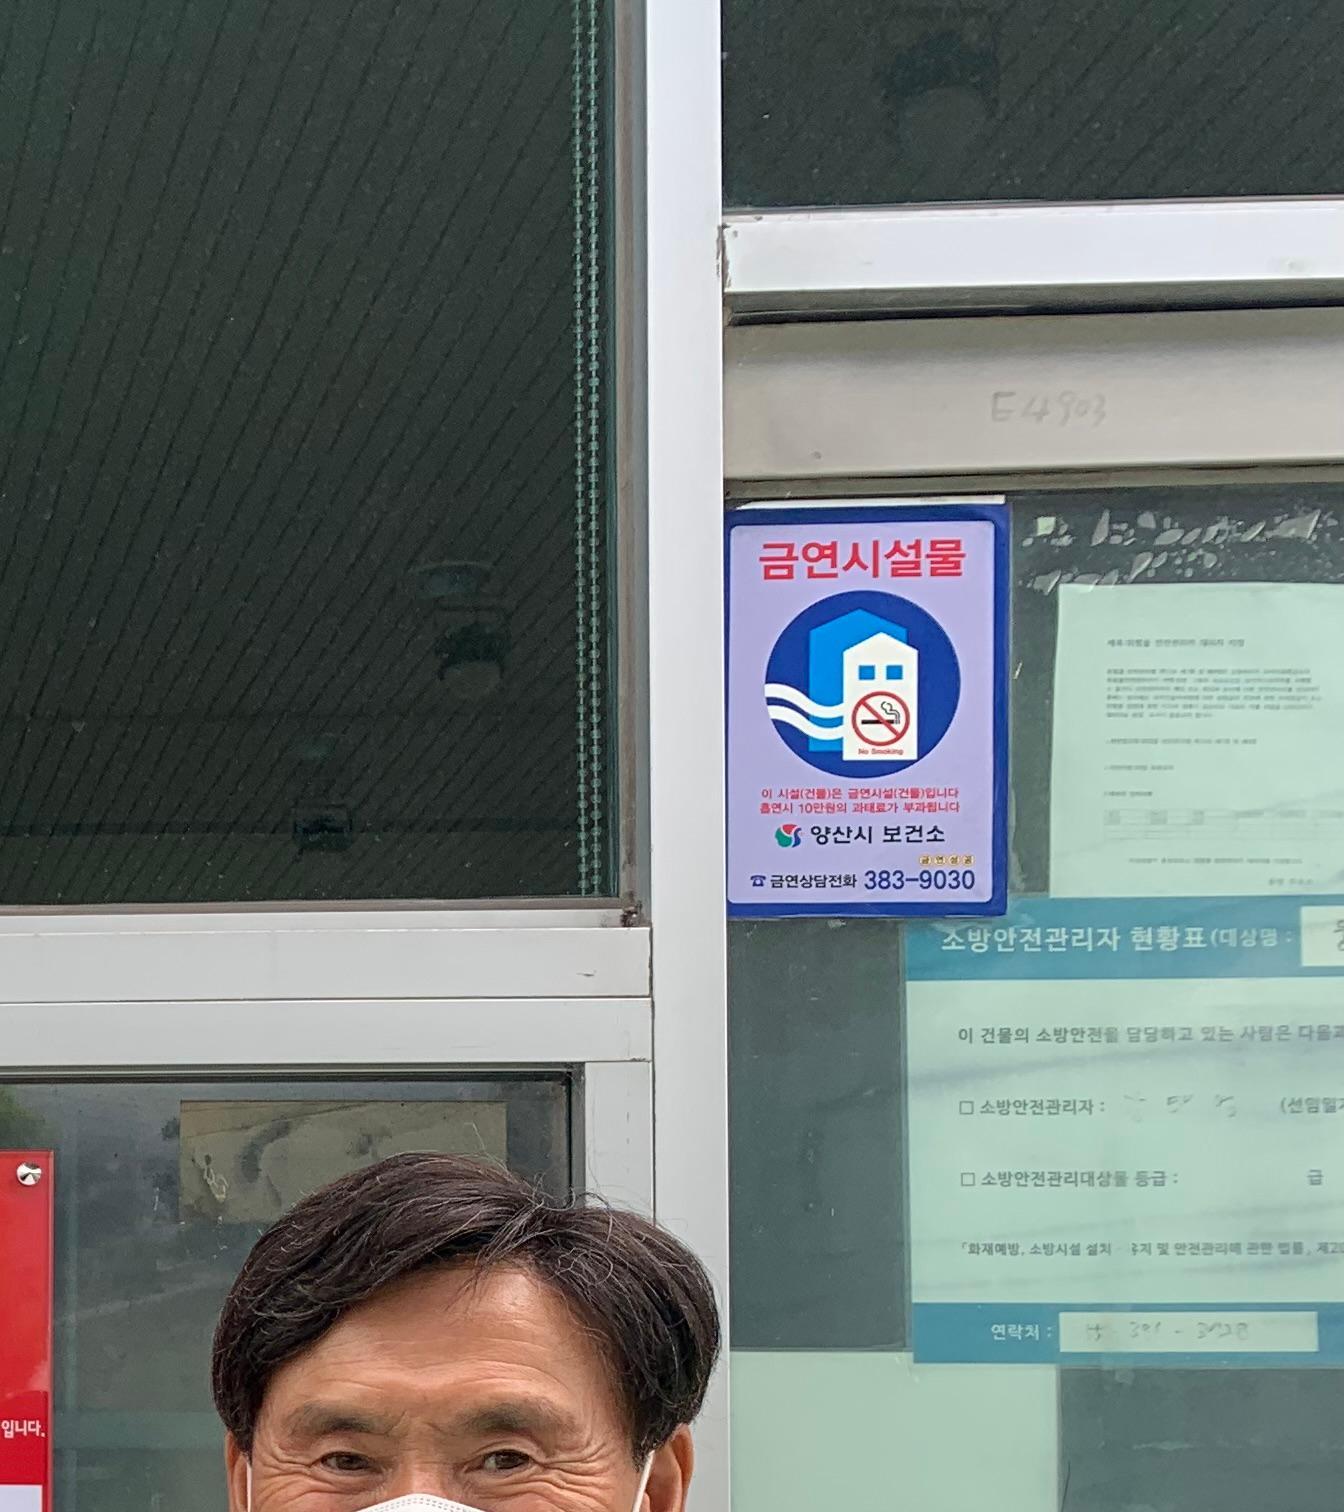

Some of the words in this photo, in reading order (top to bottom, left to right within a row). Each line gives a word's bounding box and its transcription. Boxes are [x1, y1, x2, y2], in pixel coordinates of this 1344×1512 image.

[759, 539, 966, 580] 금연시설물
[871, 748, 904, 756] Smoking
[761, 788, 772, 799] 이
[779, 787, 842, 800] 시설(건물)은
[848, 787, 959, 799] 금연시설(건물)입니다
[760, 801, 793, 815] 흡연시
[799, 802, 847, 815] 10만원의
[852, 801, 899, 814] 과태료가
[903, 802, 960, 814] 부과됩니다
[810, 824, 873, 846] 양산시
[883, 824, 945, 844] 보건소
[770, 874, 858, 888] 금연상담전화
[864, 869, 975, 890] 383-9030
[941, 926, 1121, 953] 소방안전관리자
[958, 1027, 973, 1044] 이
[981, 1027, 1030, 1044] 건물의
[1036, 1026, 1119, 1043] 소방안전을
[1126, 1026, 1194, 1043] 담당하고
[1201, 1025, 1234, 1042] 있는
[1240, 1025, 1293, 1042] 사람은
[979, 1100, 1094, 1116] 소방안전관리자
[981, 1171, 1129, 1187] 소방안전관리대상물
[1135, 1170, 1167, 1187] 등급
[1307, 1169, 1325, 1186] 급
[1029, 1242, 1082, 1256] 소방시설
[1086, 1242, 1111, 1256] 설치
[990, 1323, 1041, 1341] 연락처
[1, 1420, 46, 1438] 입니다.
